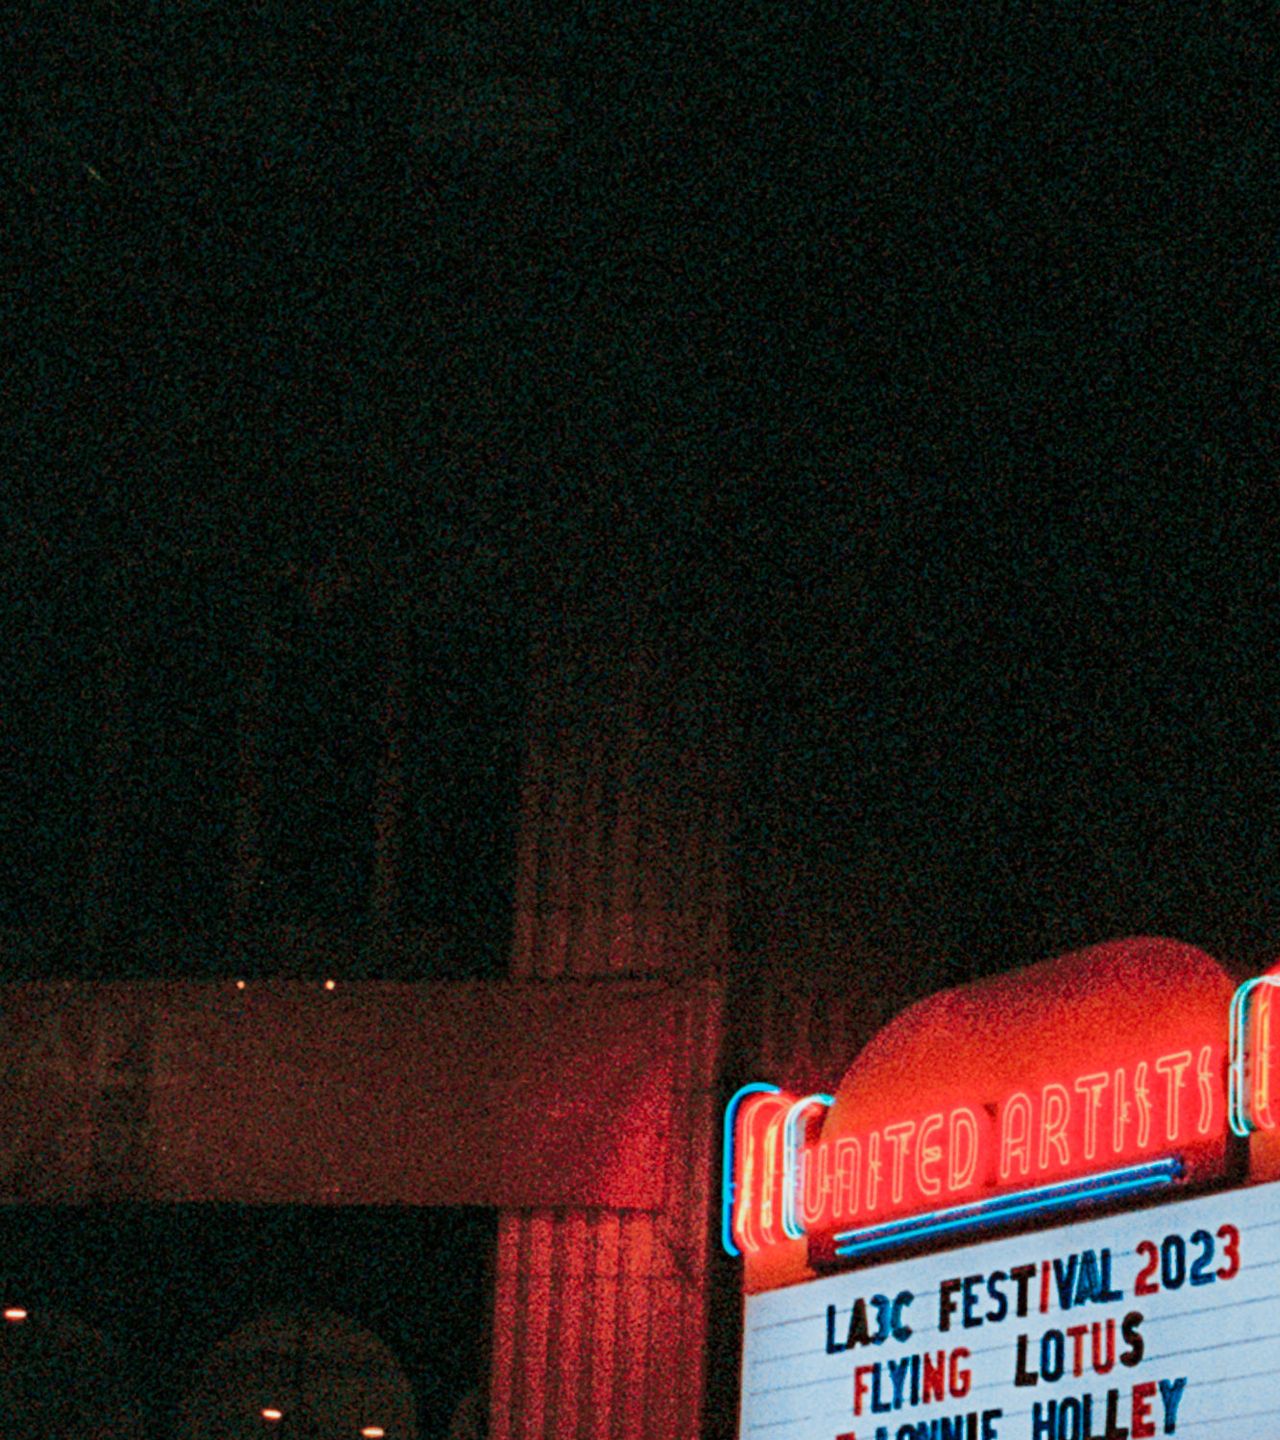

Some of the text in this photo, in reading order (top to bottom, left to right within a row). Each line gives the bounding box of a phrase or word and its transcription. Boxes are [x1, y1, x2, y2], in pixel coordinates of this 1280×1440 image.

[802, 1045, 1214, 1224] UNITED ARTISTS
[826, 1223, 1241, 1355] LA3C FESTIVAL 2023
[854, 1311, 1144, 1418] FLYING LOTUS
